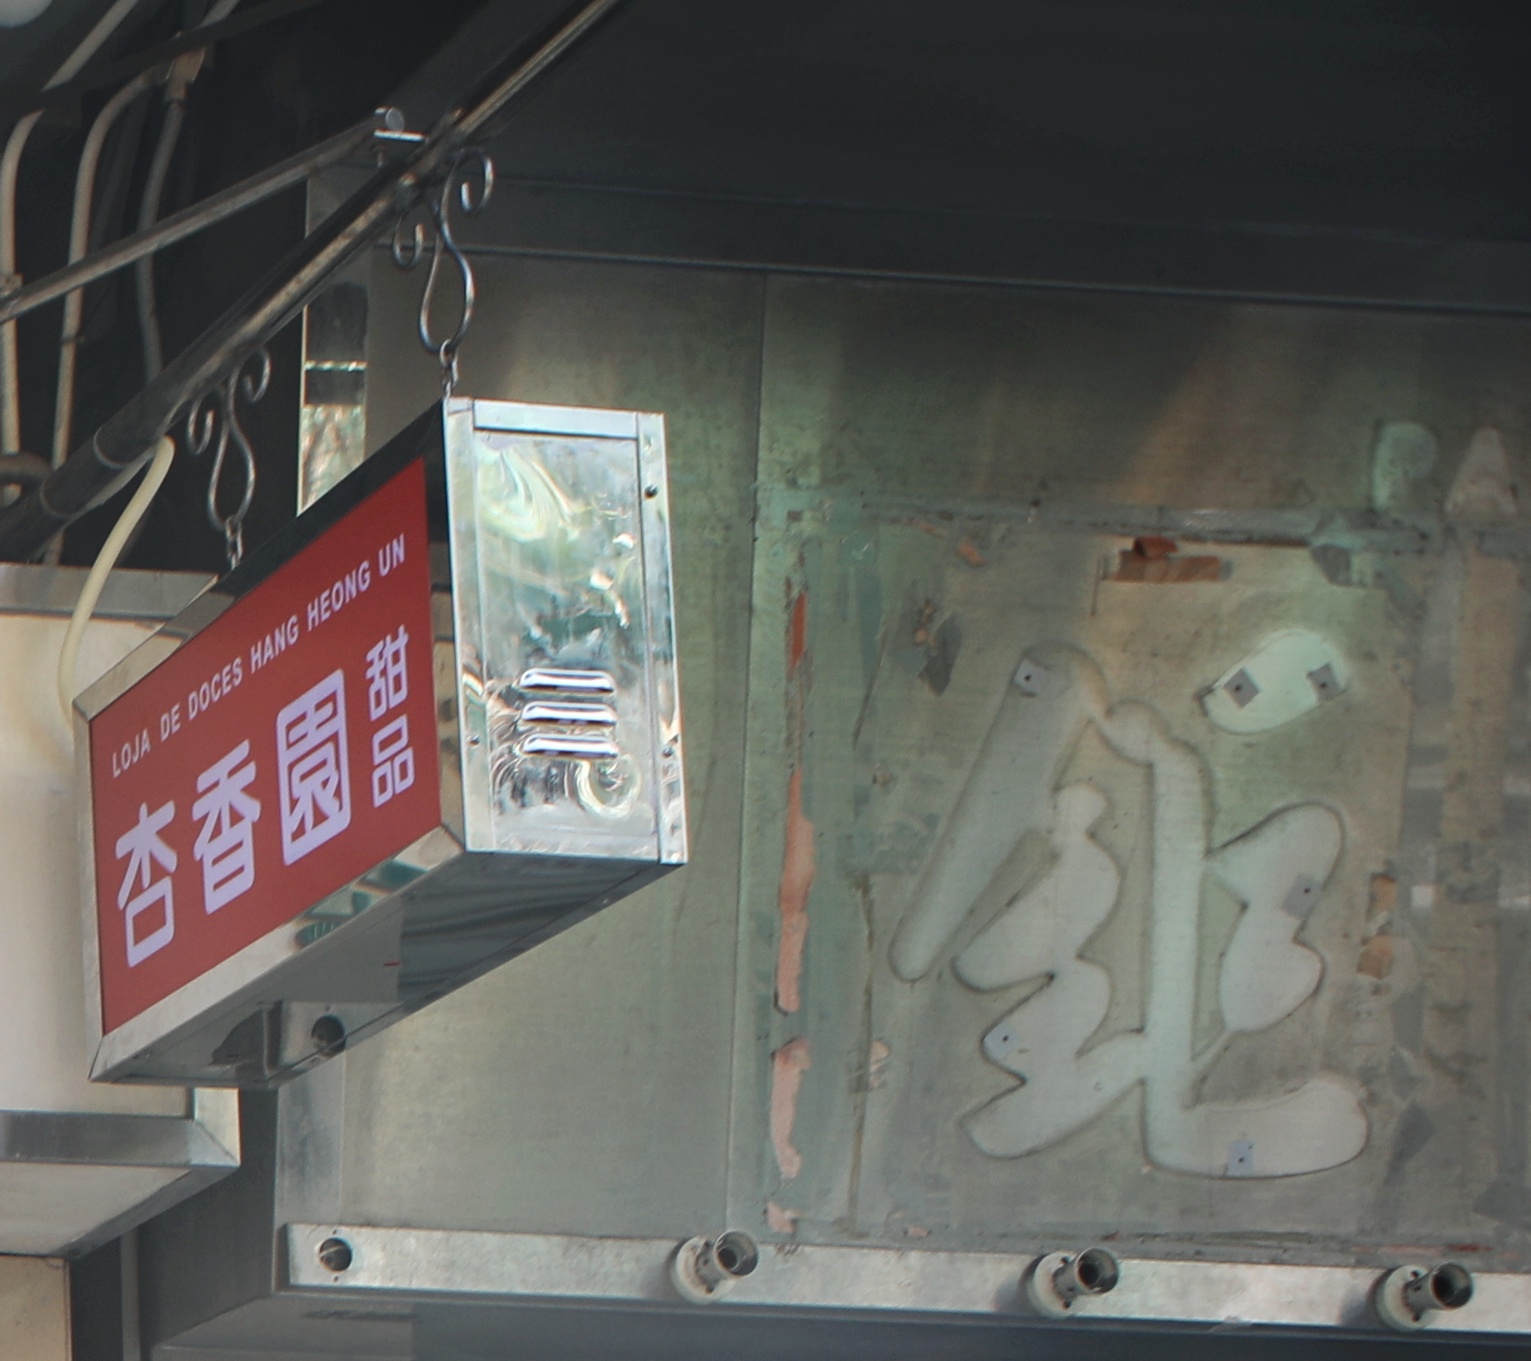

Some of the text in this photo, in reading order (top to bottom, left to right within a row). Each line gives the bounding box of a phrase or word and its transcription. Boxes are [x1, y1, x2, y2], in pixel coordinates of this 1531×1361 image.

[111, 533, 406, 779] LOJA DE DOCES HANG HEONG UN
[365, 624, 415, 809] 甜品
[114, 668, 352, 969] 杏香園
